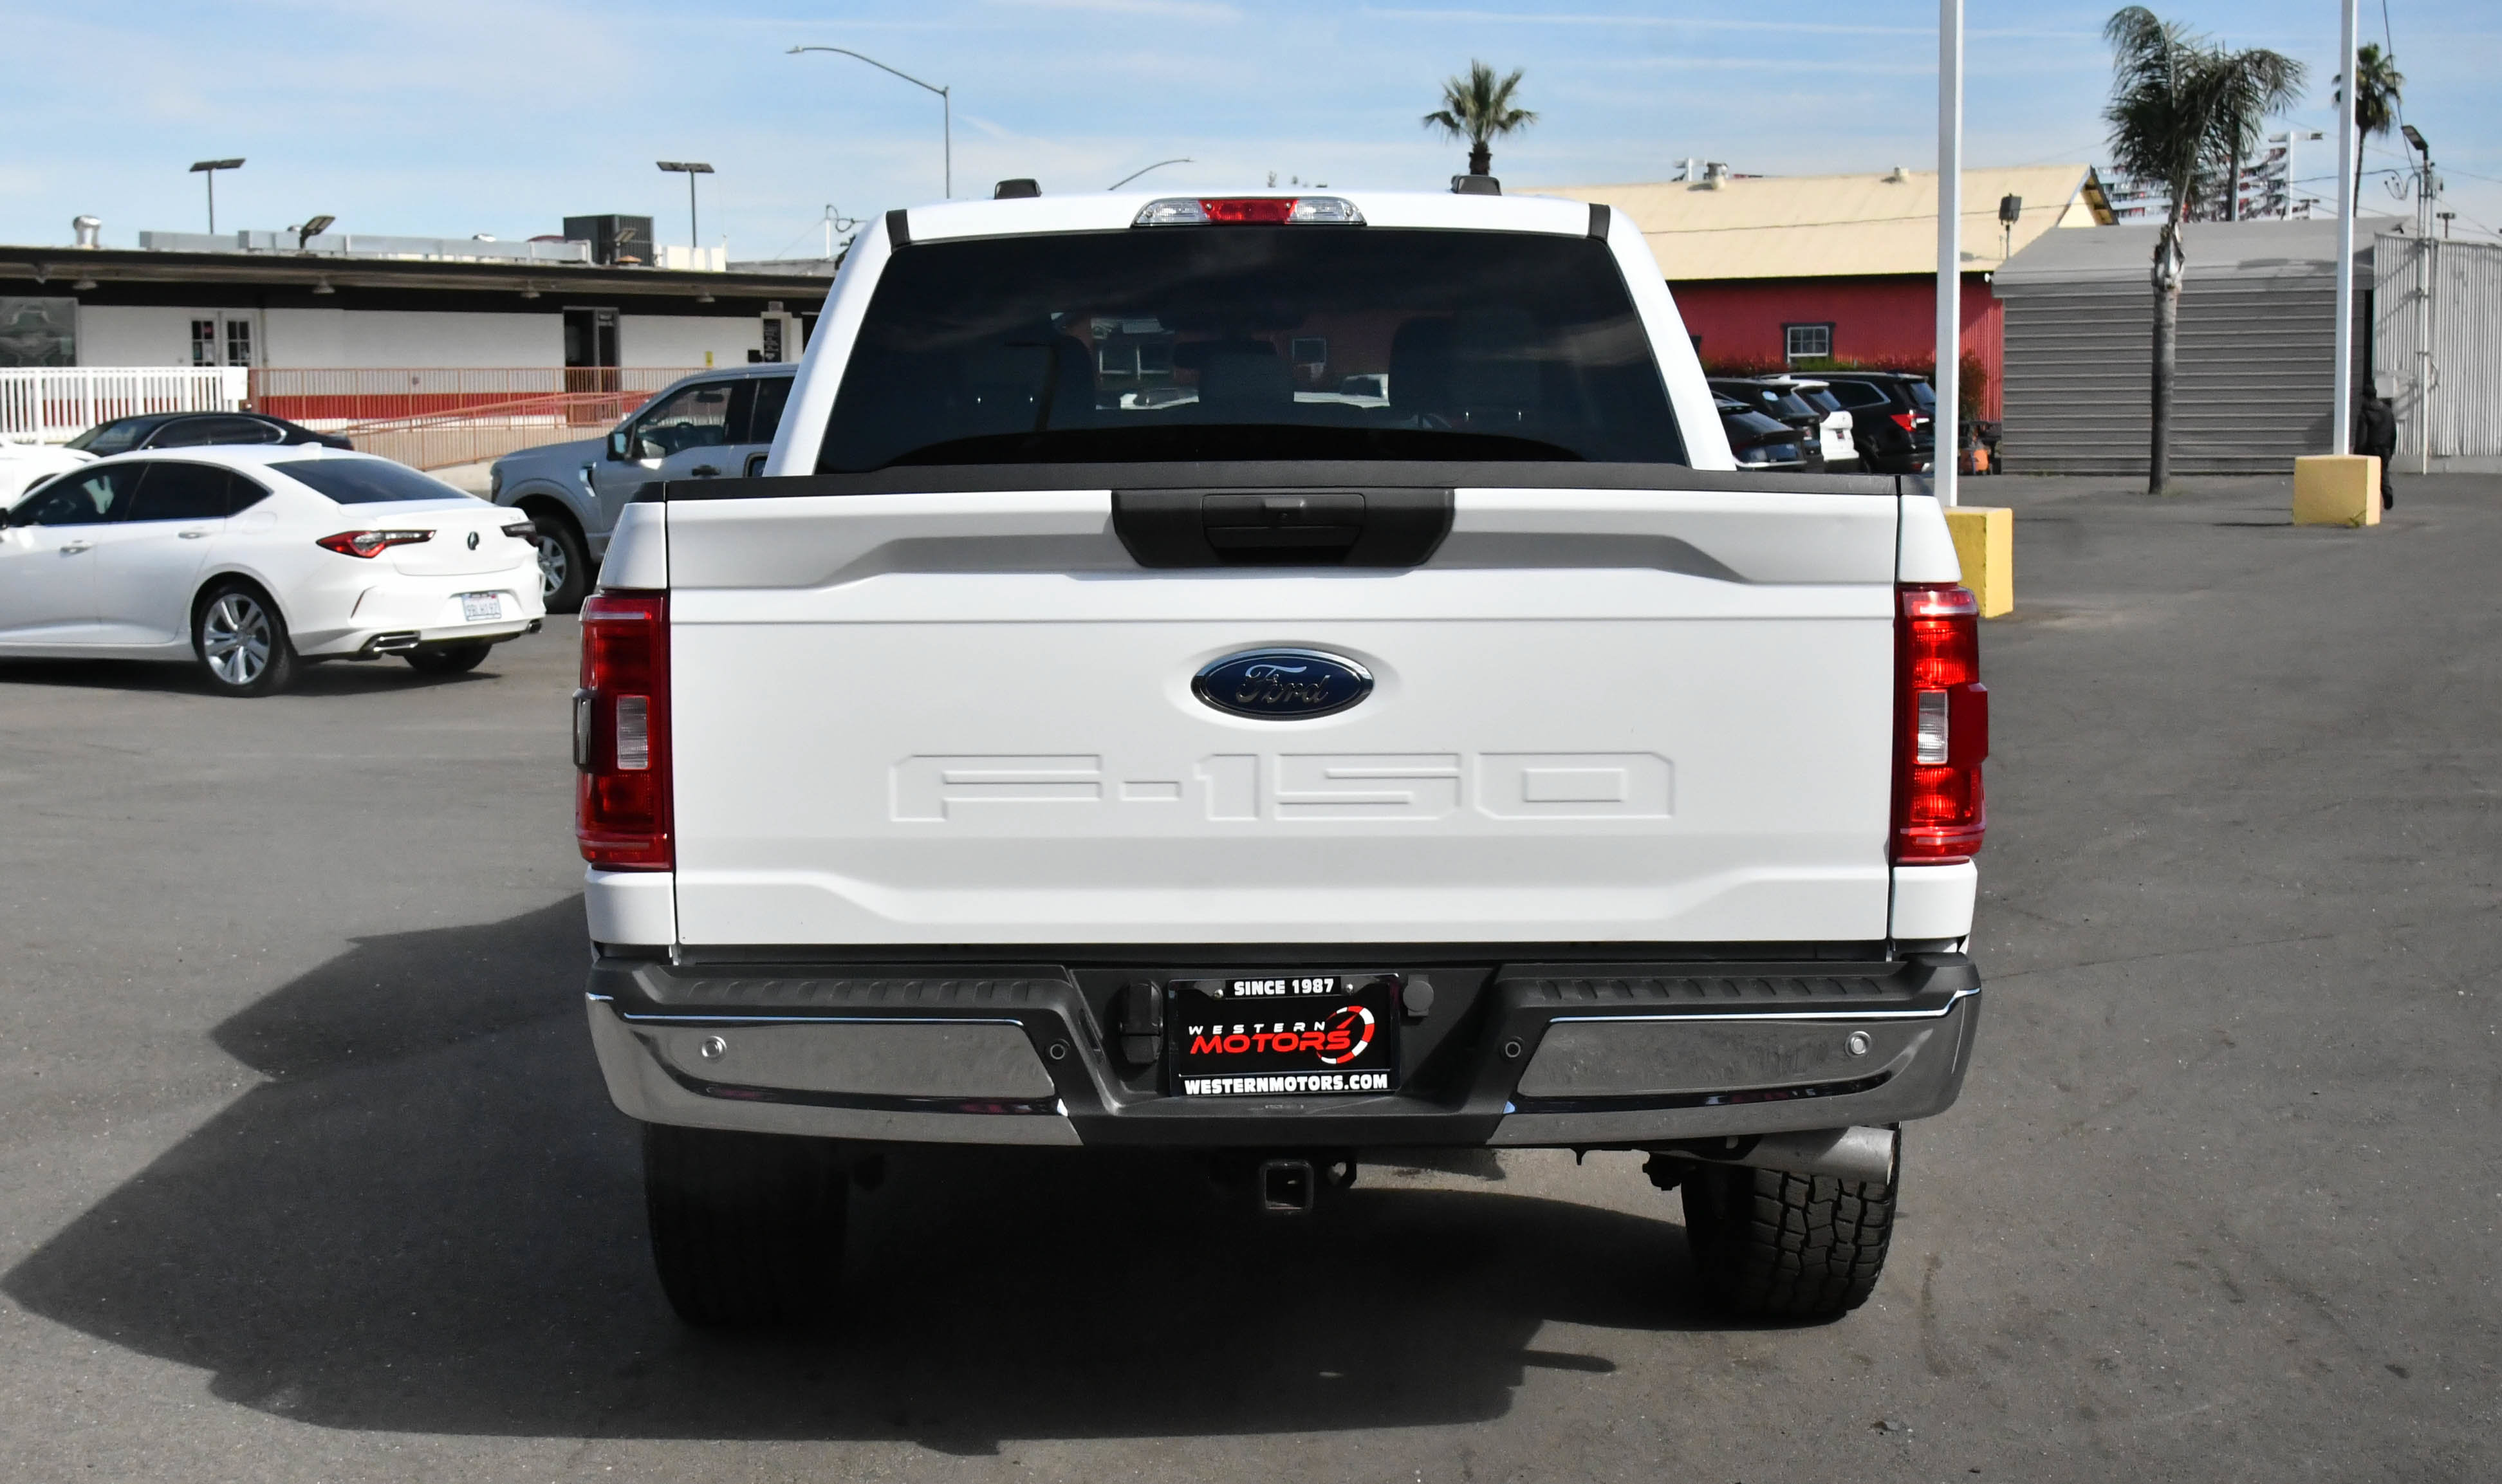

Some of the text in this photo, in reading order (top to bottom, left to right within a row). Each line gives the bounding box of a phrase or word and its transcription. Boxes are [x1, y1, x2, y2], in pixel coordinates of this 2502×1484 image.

[1236, 664, 1331, 703] Ford
[890, 754, 1673, 821] F-150
[1234, 979, 1334, 996] SINCE 1987
[1189, 1021, 1326, 1035] WESTERN
[1190, 1030, 1351, 1054] MOTORS
[1185, 1074, 1387, 1094] WESTERNMOTORS.COM
